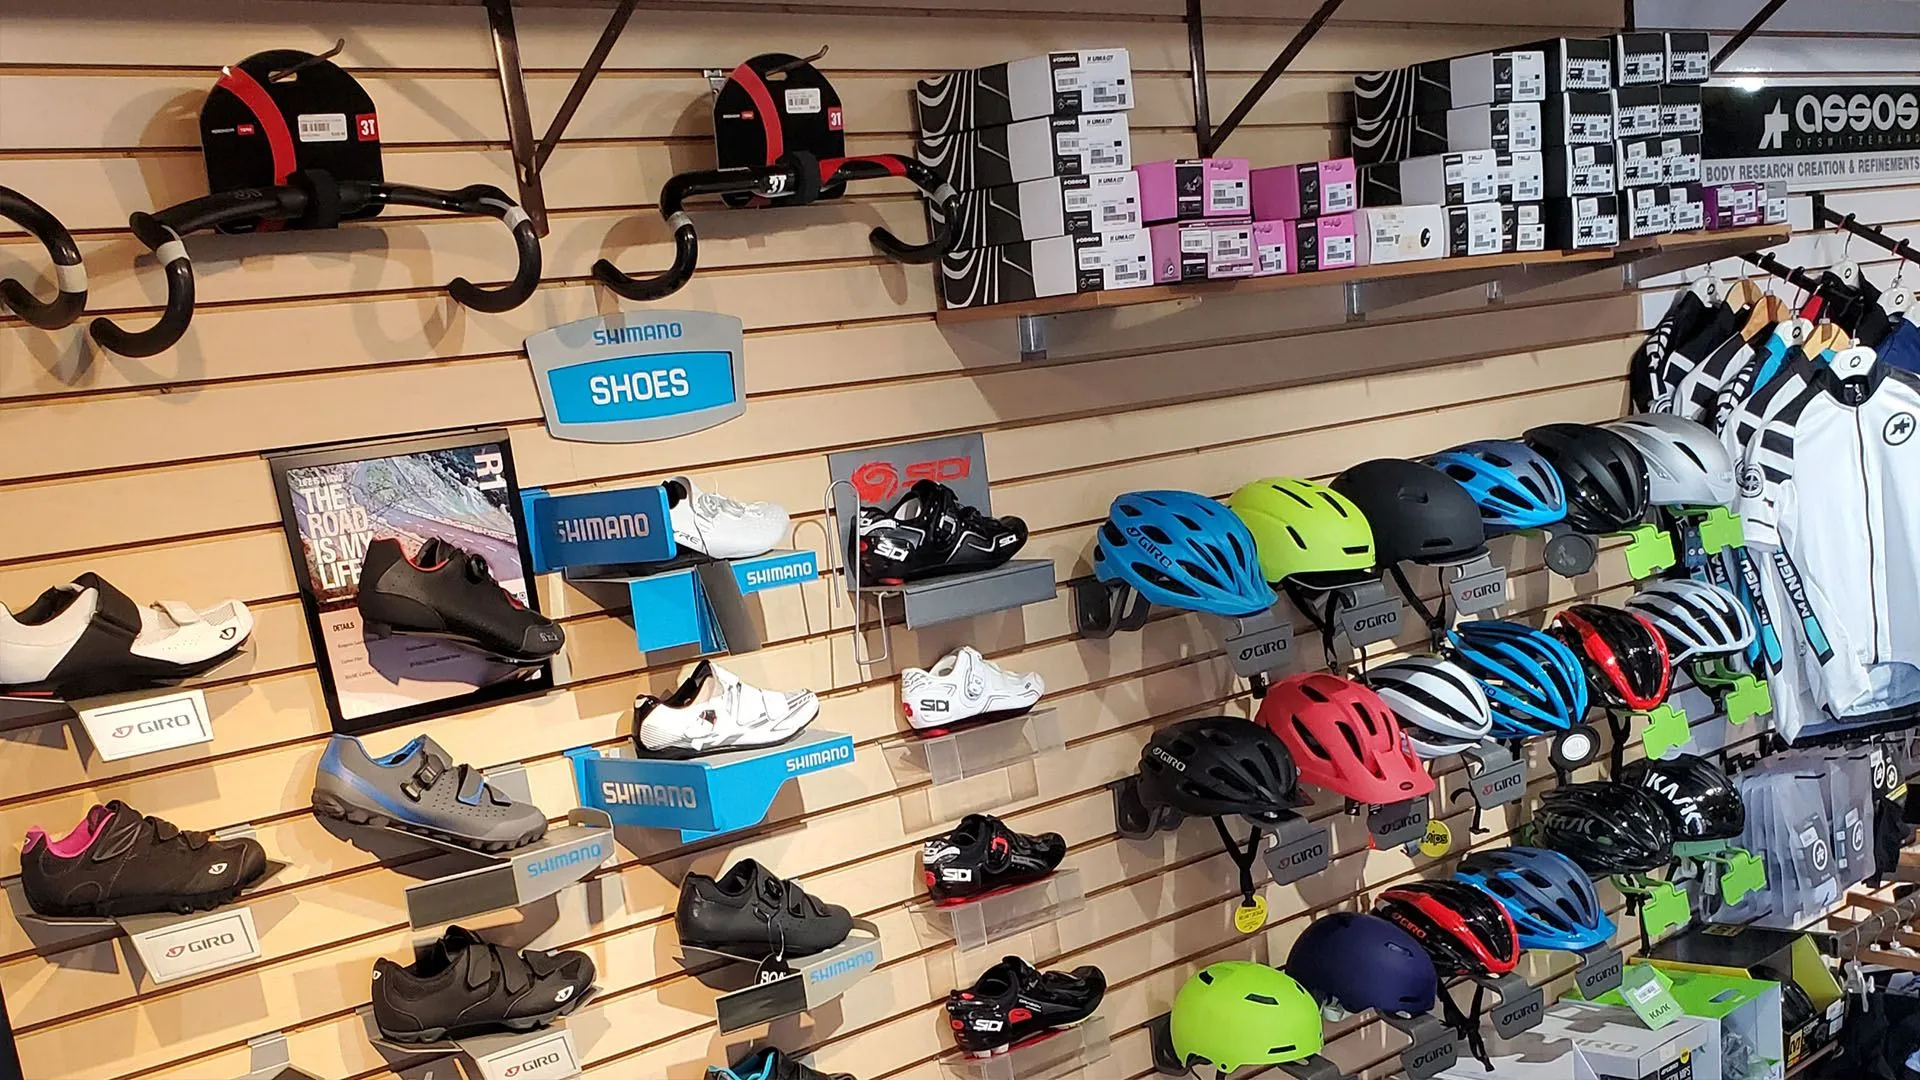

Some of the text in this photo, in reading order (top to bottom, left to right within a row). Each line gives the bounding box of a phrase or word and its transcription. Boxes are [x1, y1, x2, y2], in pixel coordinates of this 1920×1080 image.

[831, 112, 841, 126] 3T
[1795, 93, 1919, 134] assos
[360, 119, 376, 136] 3T
[1706, 156, 1920, 182] BODY RESEARCH CREATION & REFINEMENTS
[767, 174, 787, 193] 3T
[592, 322, 683, 346] SHIMANO
[589, 368, 690, 406] SHOES
[301, 484, 346, 513] THE
[306, 507, 369, 538] ROAD
[556, 512, 650, 543] SHIMANO
[312, 531, 374, 564] IS MY
[1137, 536, 1174, 569] GIRO
[318, 560, 362, 590] LIFE
[746, 561, 813, 586] SHIMANO
[1473, 582, 1501, 599] GIRO
[1368, 611, 1397, 630] GIRO
[1255, 638, 1287, 656] GIRO
[137, 714, 191, 734] GIRO
[785, 744, 850, 773] SHIMANO
[1160, 751, 1187, 772] GIRO
[1494, 773, 1522, 792] GIRO
[601, 781, 698, 809] SHIMANO
[1646, 772, 1703, 833] KASK
[1392, 813, 1422, 833] GIRO
[526, 842, 603, 880] SHIMANO
[1291, 844, 1323, 865] GIRO
[942, 868, 972, 882] SIDI
[1400, 917, 1427, 940] GIRO
[188, 932, 235, 954] GIRO
[810, 951, 876, 985] SHIMANO
[1596, 964, 1619, 982] GIRO
[1512, 1002, 1540, 1020] GIRO
[522, 1052, 560, 1073] GIRO
[1426, 1043, 1453, 1064] GIRO
